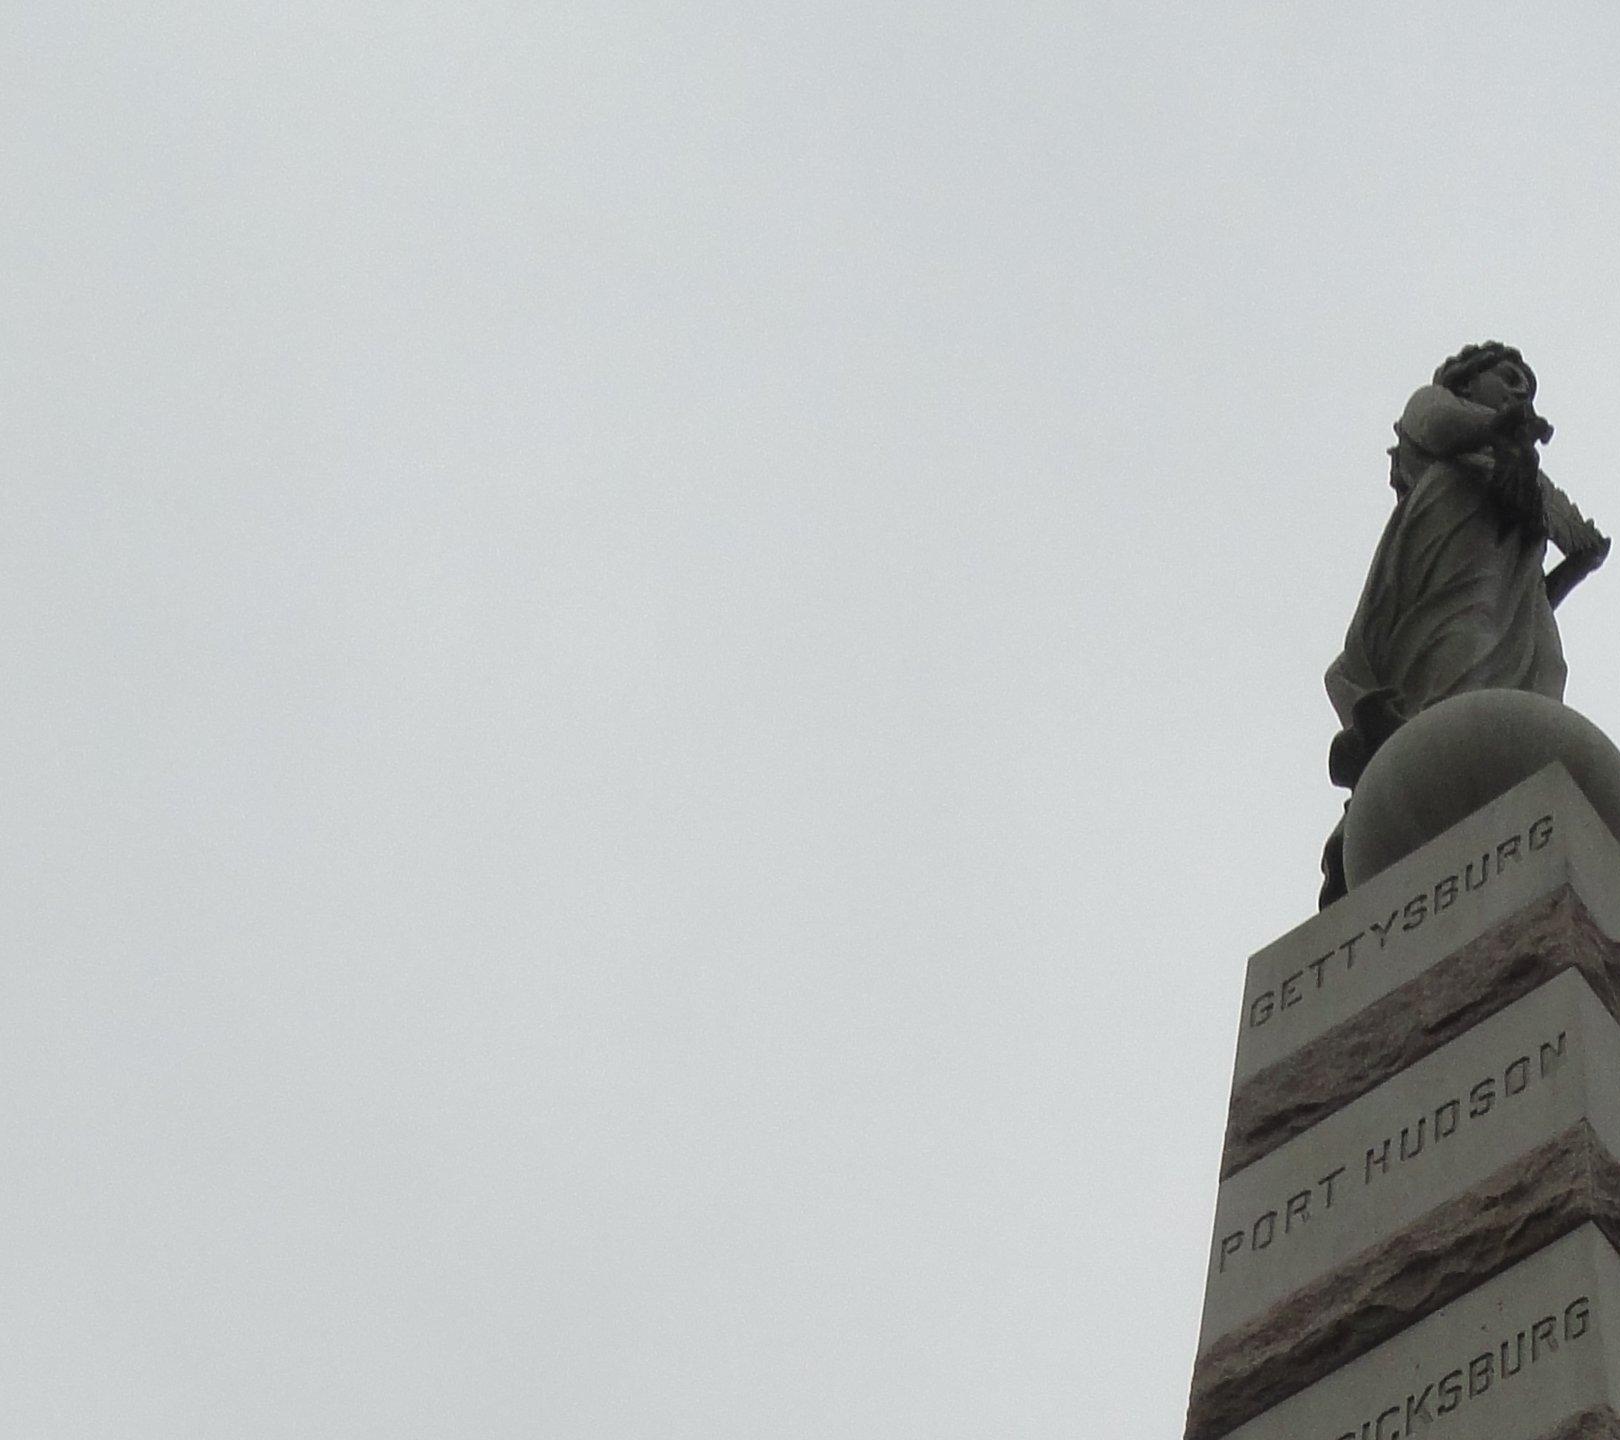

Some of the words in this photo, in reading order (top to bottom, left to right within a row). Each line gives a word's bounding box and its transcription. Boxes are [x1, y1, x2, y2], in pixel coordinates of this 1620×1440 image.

[1249, 814, 1555, 1028] GETTYSBURG
[1218, 1166, 1346, 1273] PORT
[1362, 1031, 1568, 1185] HUDSON
